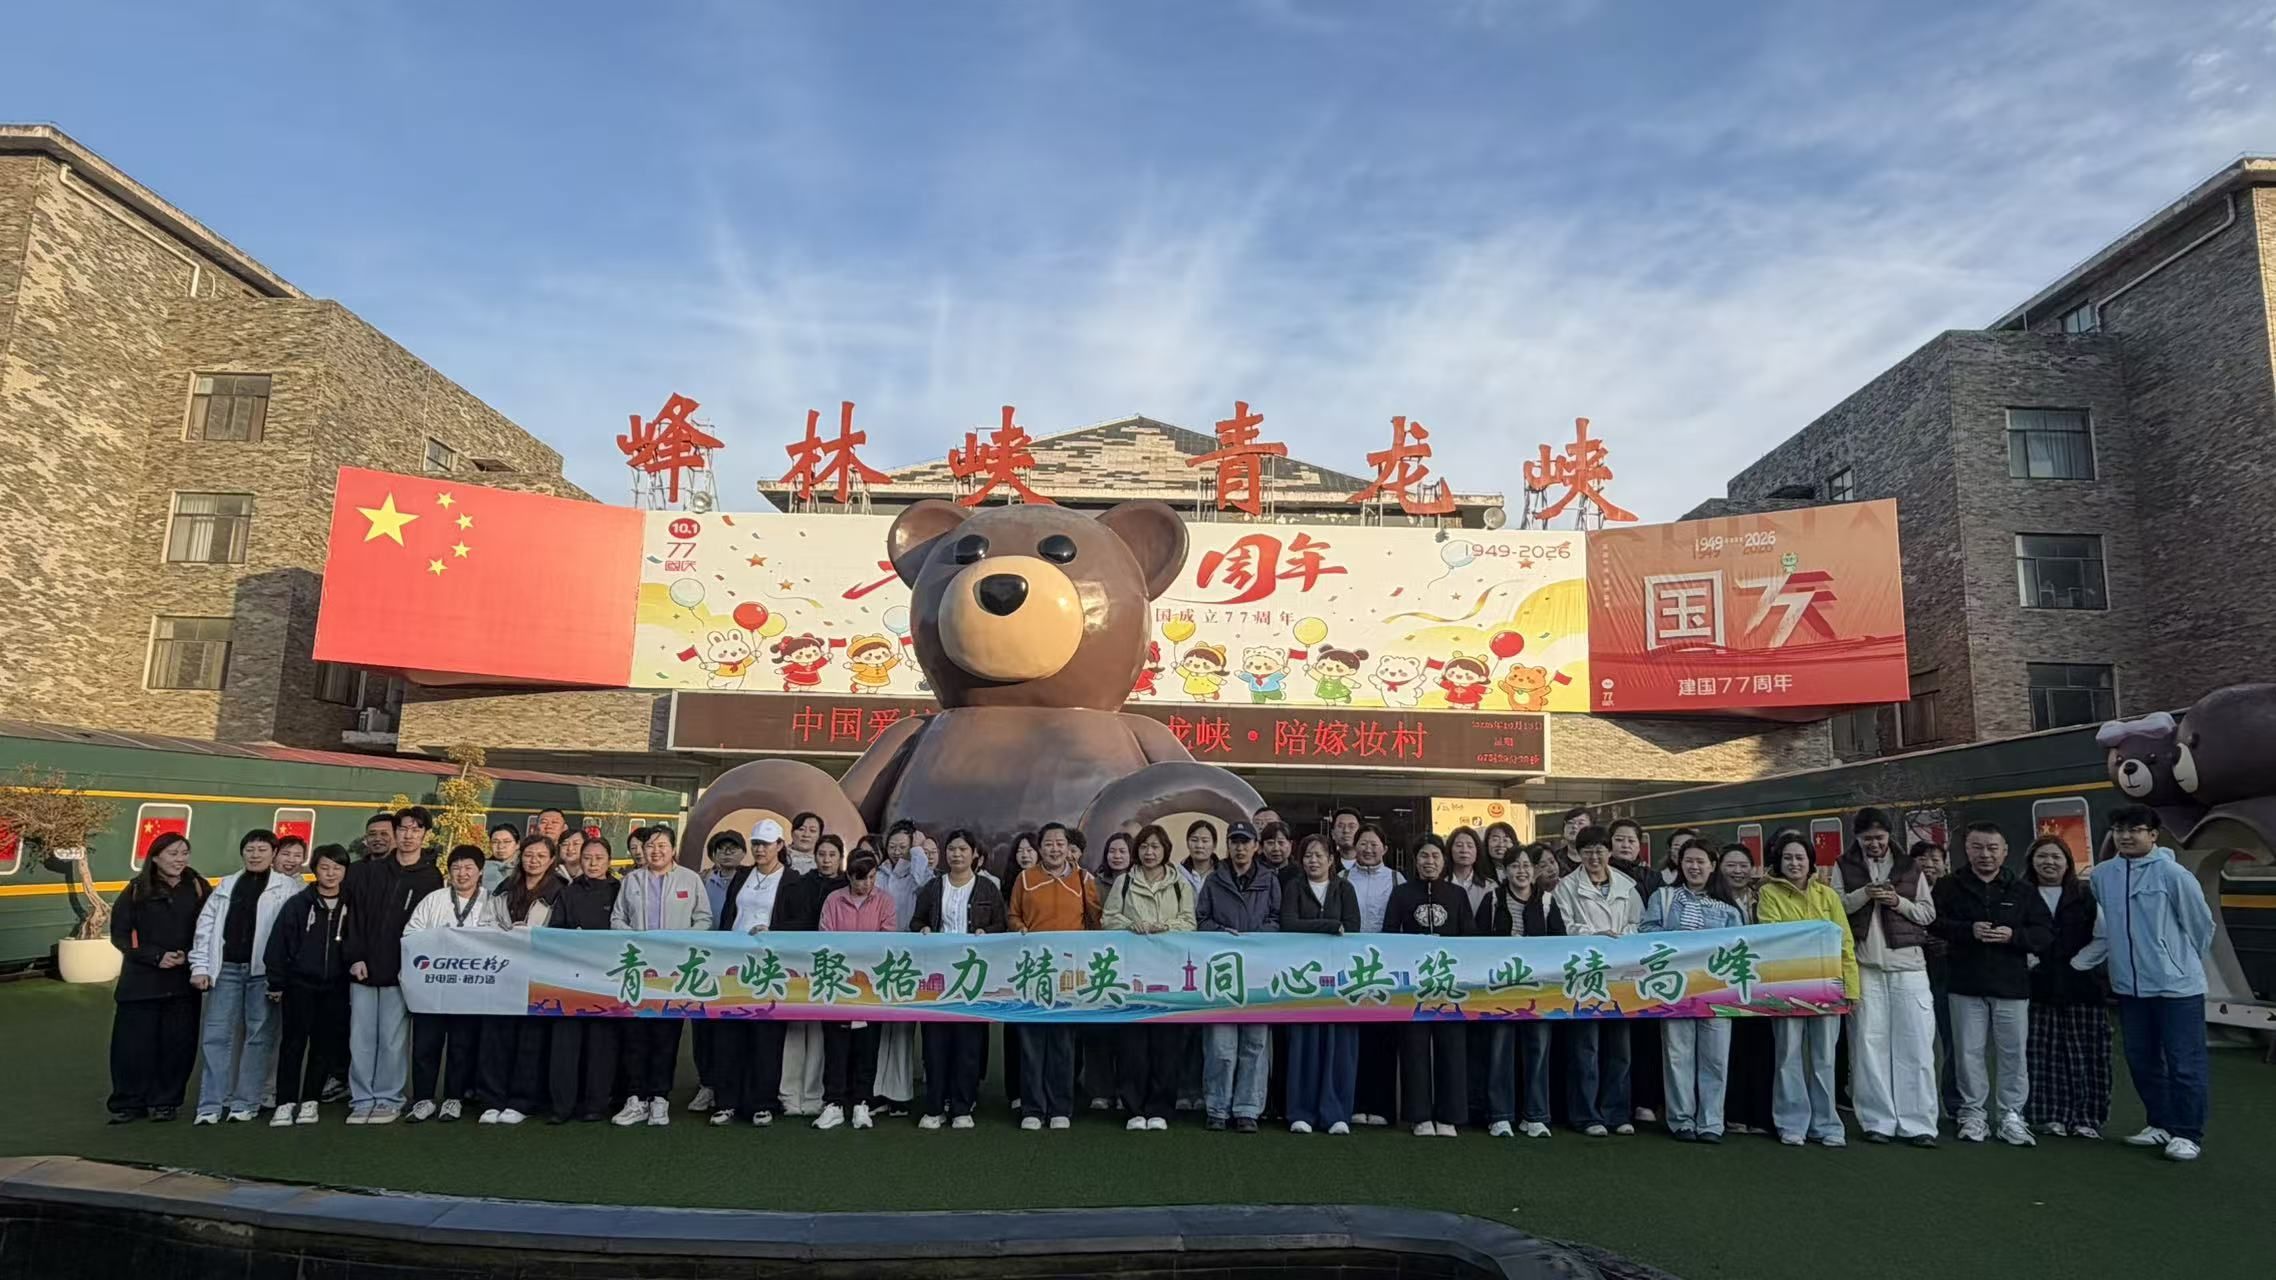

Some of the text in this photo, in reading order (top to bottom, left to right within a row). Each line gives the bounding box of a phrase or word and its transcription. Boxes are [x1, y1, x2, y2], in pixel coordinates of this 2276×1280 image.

[672, 523, 698, 534] 10.1
[667, 542, 697, 558] 77
[1465, 541, 1571, 559] 1949-2026
[1677, 674, 1793, 697] 建国77周年
[792, 705, 932, 744] 中国爱
[433, 958, 482, 970] GREE
